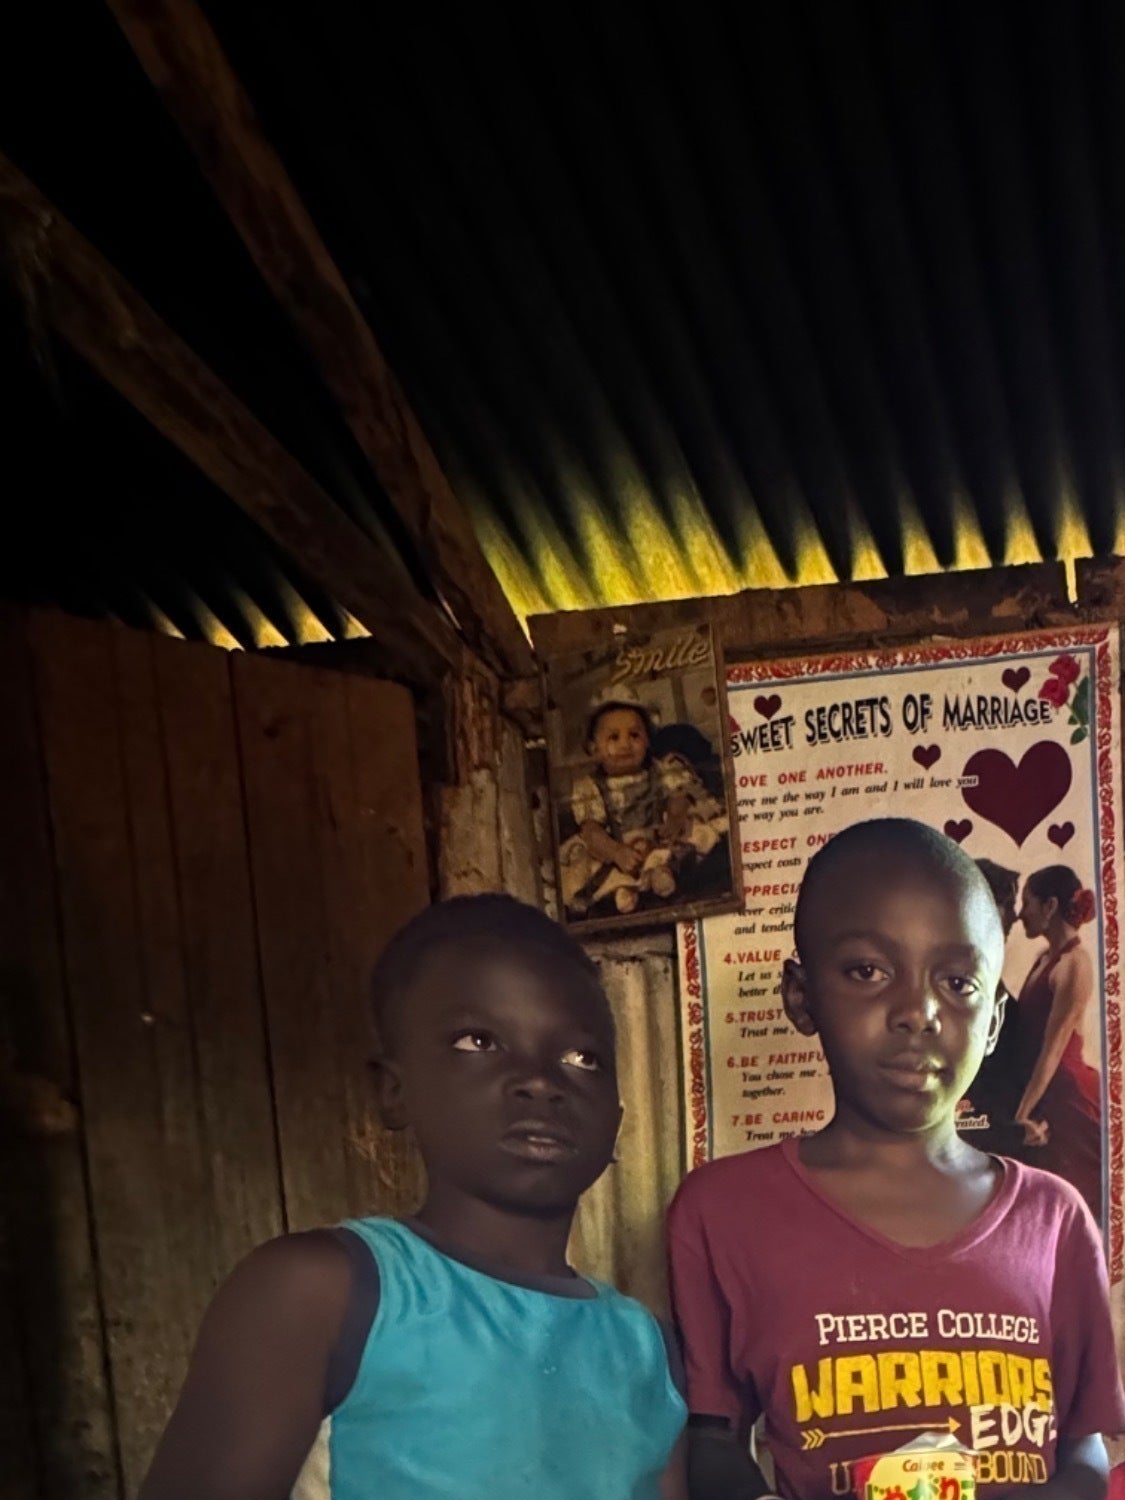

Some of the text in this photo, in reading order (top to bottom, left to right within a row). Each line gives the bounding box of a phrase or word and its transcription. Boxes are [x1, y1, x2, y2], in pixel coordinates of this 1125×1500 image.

[729, 693, 1053, 757] SWEET SECRETS OF MARRIAGE
[735, 762, 888, 789] OVE ONE ANOTHER.
[737, 799, 756, 807] ove
[761, 796, 778, 805] me
[783, 790, 800, 803] the
[804, 790, 825, 801] way
[841, 786, 859, 796] am
[864, 781, 888, 794] and
[904, 778, 924, 790] will
[929, 776, 952, 788] love
[754, 812, 774, 822] way
[779, 808, 798, 822] you
[740, 837, 797, 853] ESPECT
[743, 883, 800, 897] PPRECI
[734, 923, 756, 935] and
[772, 1109, 825, 1124] CARING
[814, 1309, 1041, 1346] PIERCE COLLEGE
[791, 1350, 1052, 1423] WARRIORS
[902, 1459, 945, 1472] Caee
[976, 1451, 1048, 1485] BOUND
